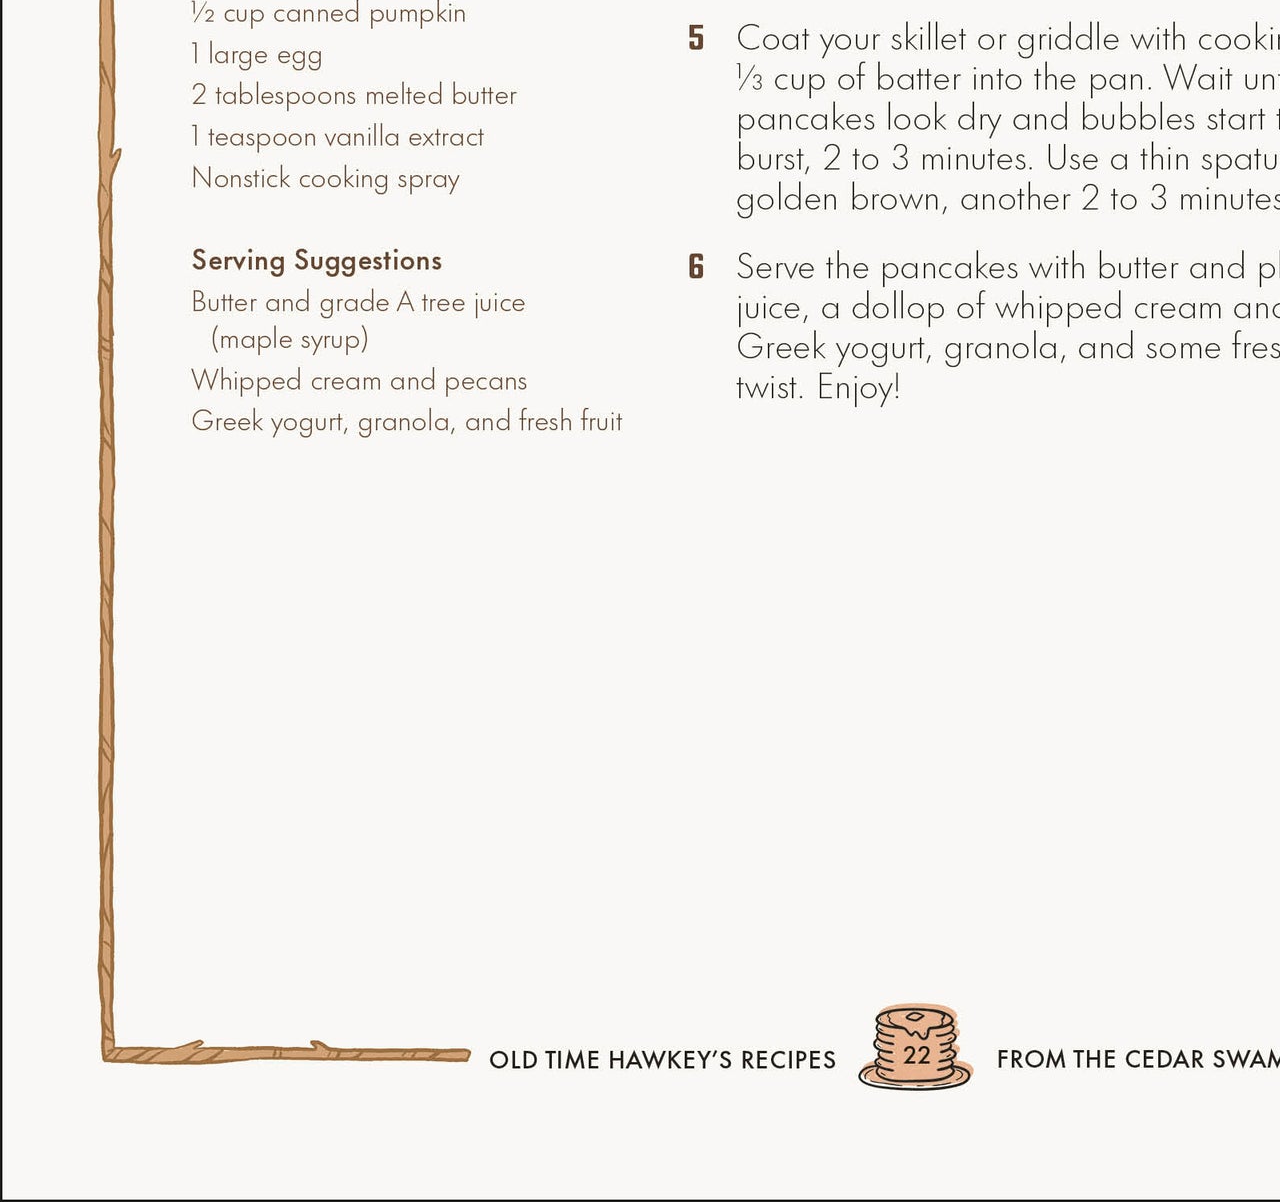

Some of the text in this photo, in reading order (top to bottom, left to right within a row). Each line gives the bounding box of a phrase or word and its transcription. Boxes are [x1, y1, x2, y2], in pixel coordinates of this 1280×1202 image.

[224, 8, 265, 30] cup
[738, 140, 810, 175] burst,
[823, 143, 841, 171] 2
[851, 147, 879, 171] to
[892, 143, 909, 171] 3
[922, 146, 1033, 171] minutes.
[1047, 143, 1099, 171] Use
[1110, 153, 1128, 171] a
[1139, 140, 1189, 171] thin
[192, 163, 461, 196] Nonstick cooking spray
[192, 247, 442, 278] Serving Suggestions
[192, 287, 526, 320] Butter and grade A tree juice
[212, 324, 368, 356] (maple syrup)
[735, 371, 899, 408] twist. Enjoy!
[192, 407, 623, 439] Greek yogurt, granola, and fresh fruit
[489, 1049, 538, 1070] OLD
[544, 1049, 600, 1070] TIME
[741, 1049, 836, 1070] RECIPES
[903, 1045, 931, 1065] 22
[997, 1048, 1067, 1069] FROM
[1072, 1049, 1116, 1069] THE
[1125, 1048, 1205, 1069] CEDAR
